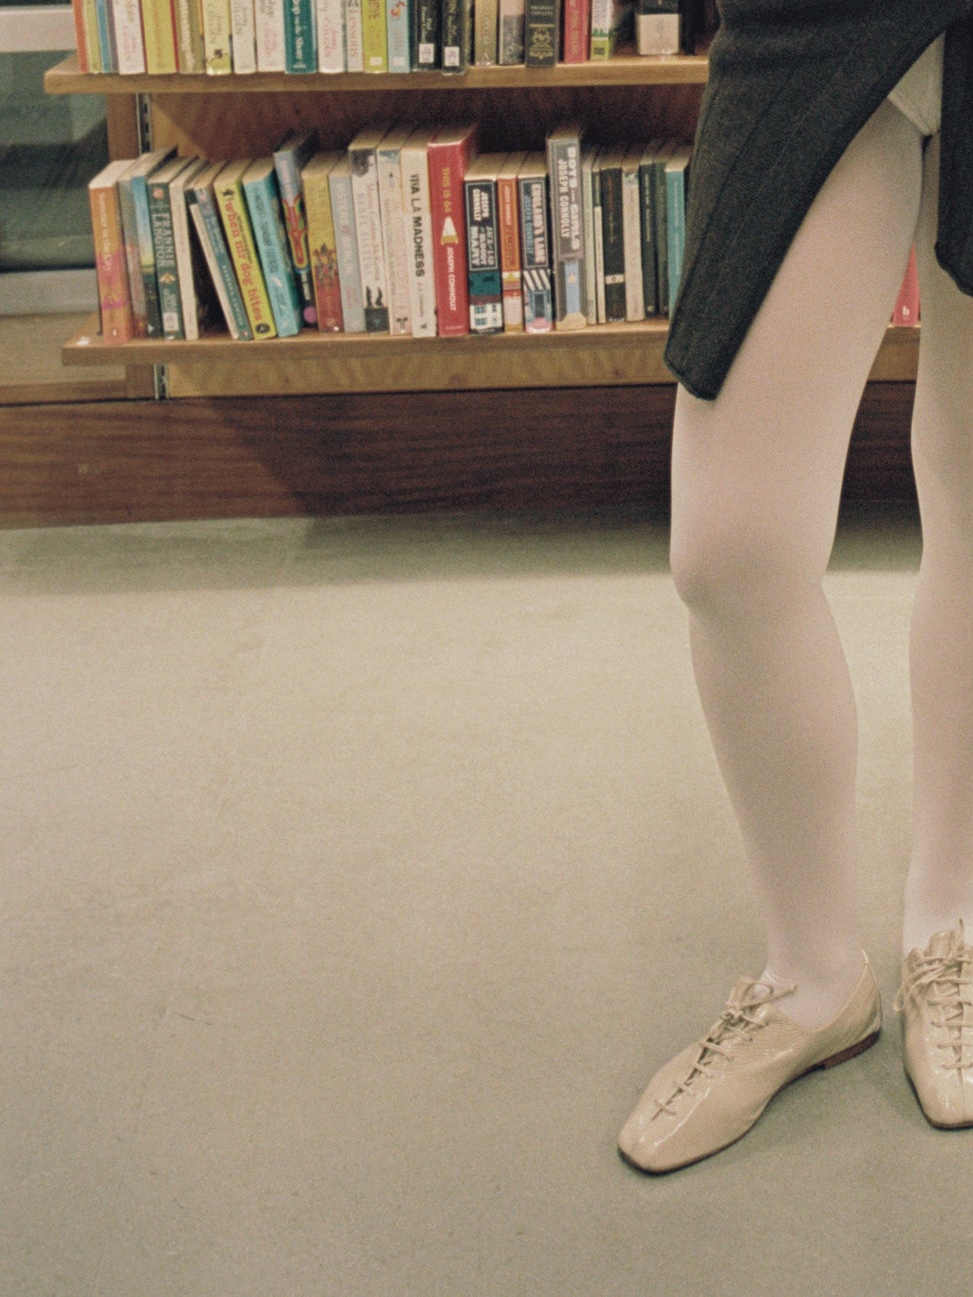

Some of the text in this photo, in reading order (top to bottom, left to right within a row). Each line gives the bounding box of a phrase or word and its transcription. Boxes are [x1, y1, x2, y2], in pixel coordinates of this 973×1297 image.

[225, 201, 240, 238] when
[473, 189, 482, 221] CONNOLLY
[481, 191, 489, 217] JOSEPH
[557, 158, 570, 238] JOSEPH CONNOLLY
[152, 214, 165, 267] LANGTON
[162, 212, 174, 267] FRANNIE
[412, 198, 426, 278] LA MADNESS
[442, 167, 457, 311] THIS IS 64 JOSEPH CONNOLLY
[470, 226, 480, 266] MARY
[240, 263, 263, 321] dog bites
